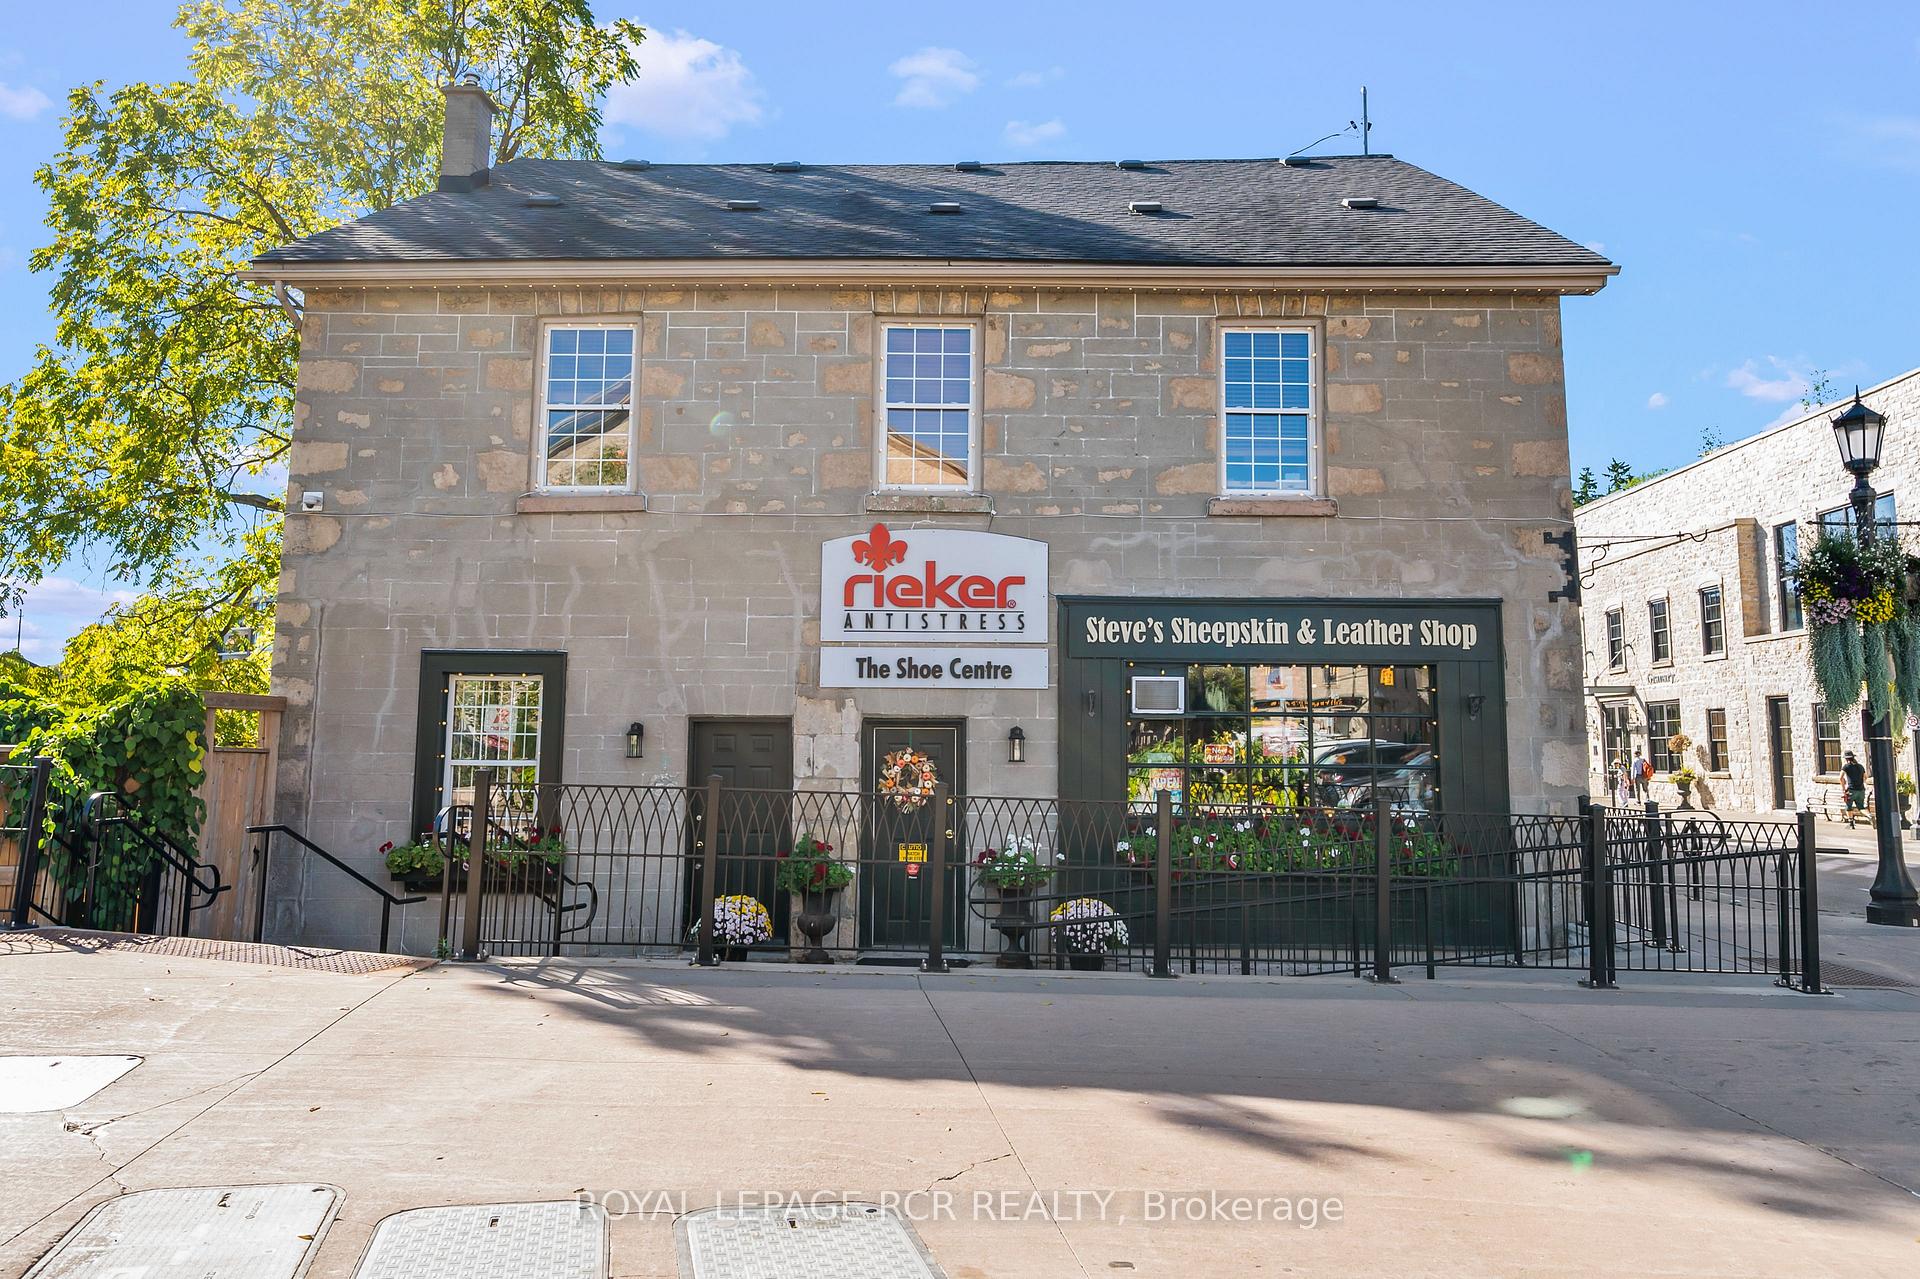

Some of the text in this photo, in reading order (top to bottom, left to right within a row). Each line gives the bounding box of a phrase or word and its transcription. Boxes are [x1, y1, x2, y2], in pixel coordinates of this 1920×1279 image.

[844, 561, 1025, 608] rieker
[844, 612, 1025, 630] ANTISTRESS
[1086, 616, 1477, 650] Steve's Sheepskin & Leather Shop
[856, 656, 1012, 680] The Shoe Centre
